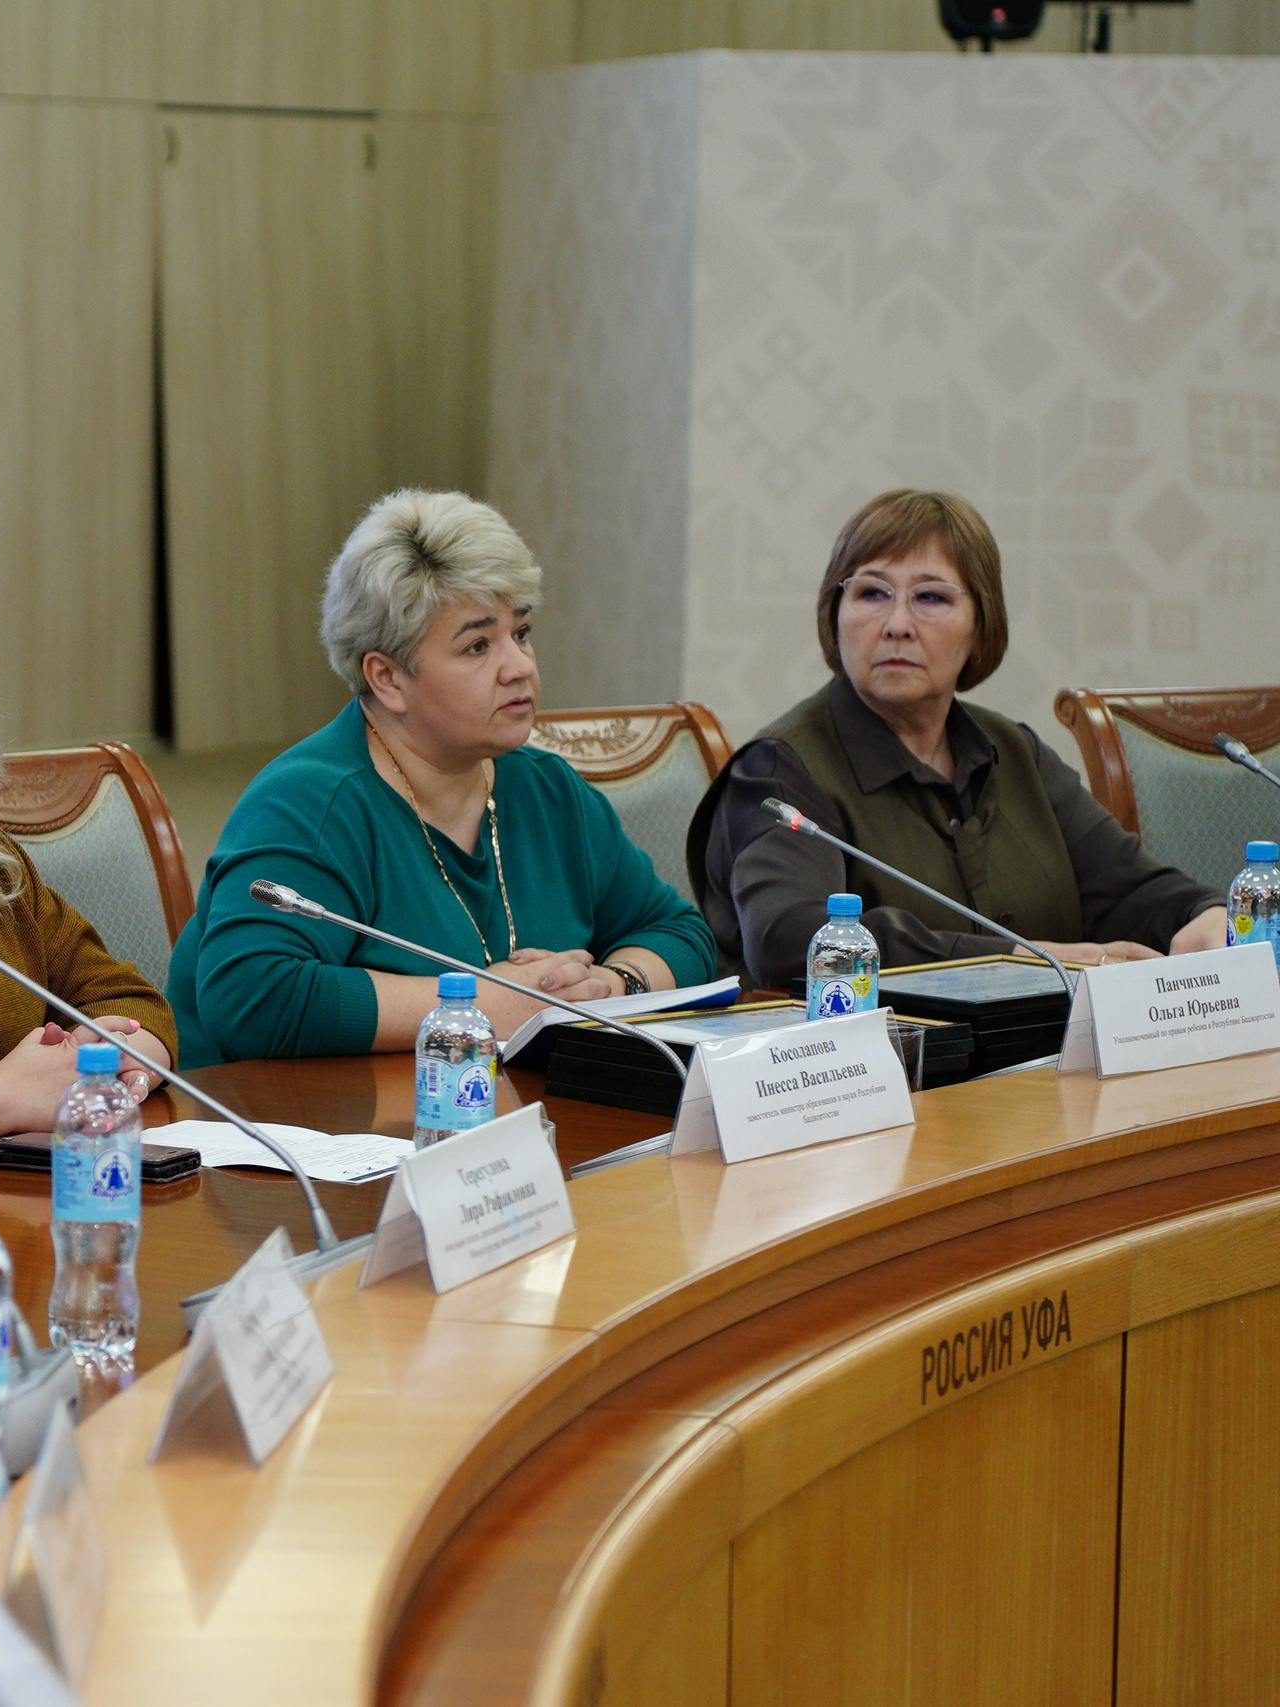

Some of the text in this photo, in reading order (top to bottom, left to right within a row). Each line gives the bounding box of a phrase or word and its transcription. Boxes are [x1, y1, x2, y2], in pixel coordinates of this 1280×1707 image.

[1155, 973, 1220, 994] Панчихина
[1148, 997, 1240, 1022] Ольга Юрьевна
[769, 1039, 837, 1064] Косолапова
[755, 1062, 868, 1098] Инесса Васильевна
[922, 1290, 1072, 1406] РОССИЯ УФА
